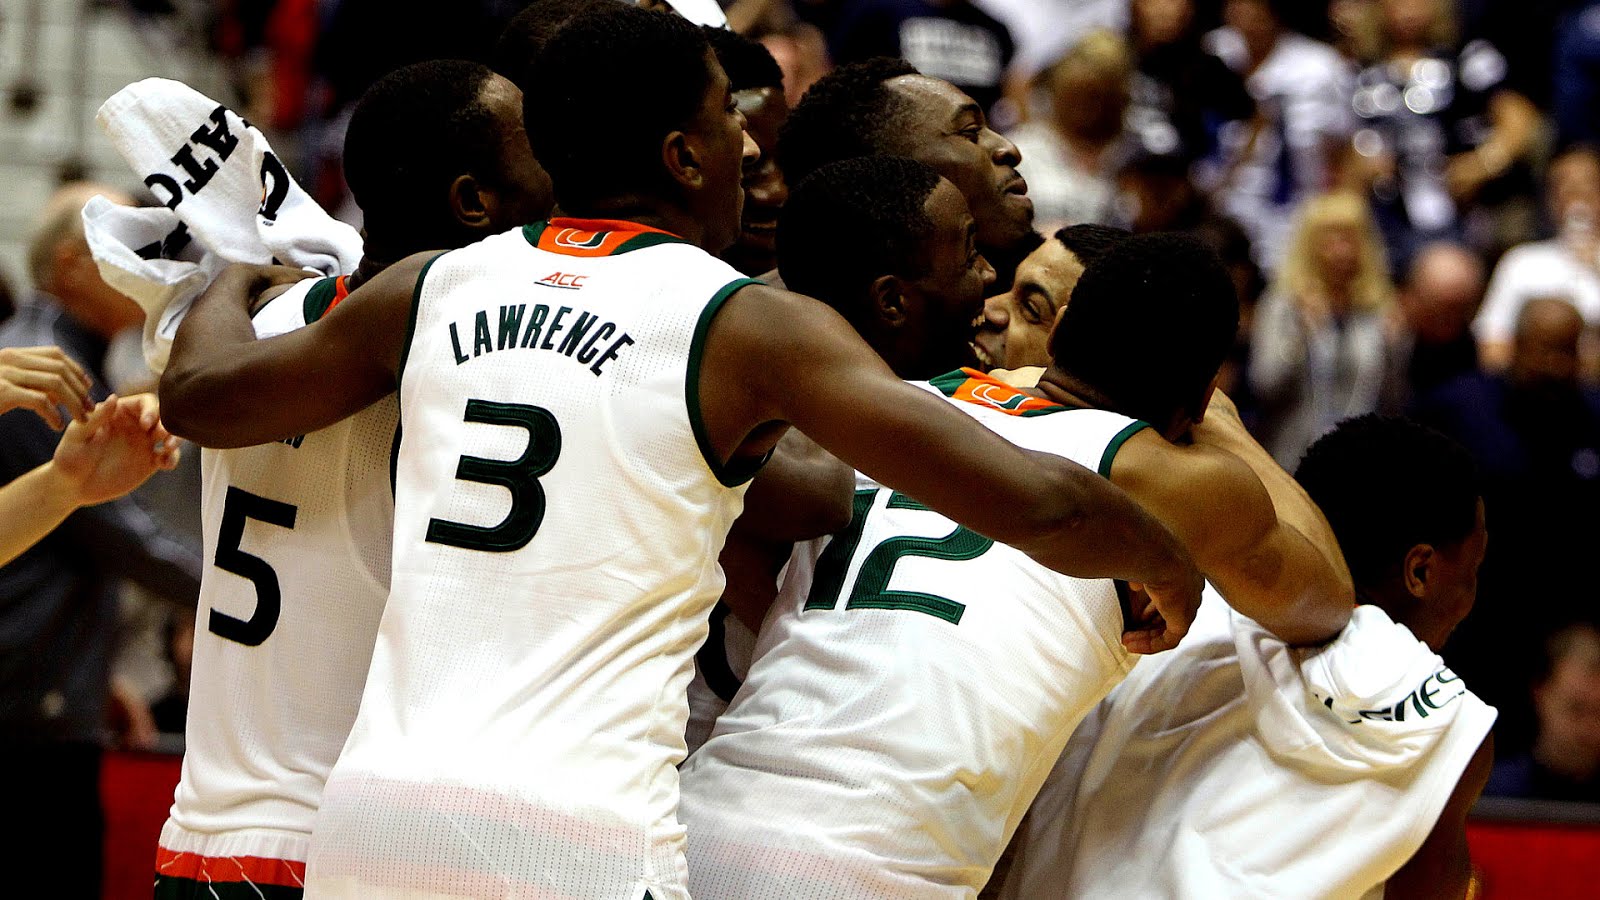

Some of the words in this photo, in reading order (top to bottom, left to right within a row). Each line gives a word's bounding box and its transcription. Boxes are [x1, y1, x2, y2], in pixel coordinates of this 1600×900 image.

[449, 303, 635, 377] LAWRENCE
[540, 271, 592, 287] ACC
[425, 398, 562, 552] 3
[208, 485, 298, 647] 5
[803, 488, 995, 625] 12
